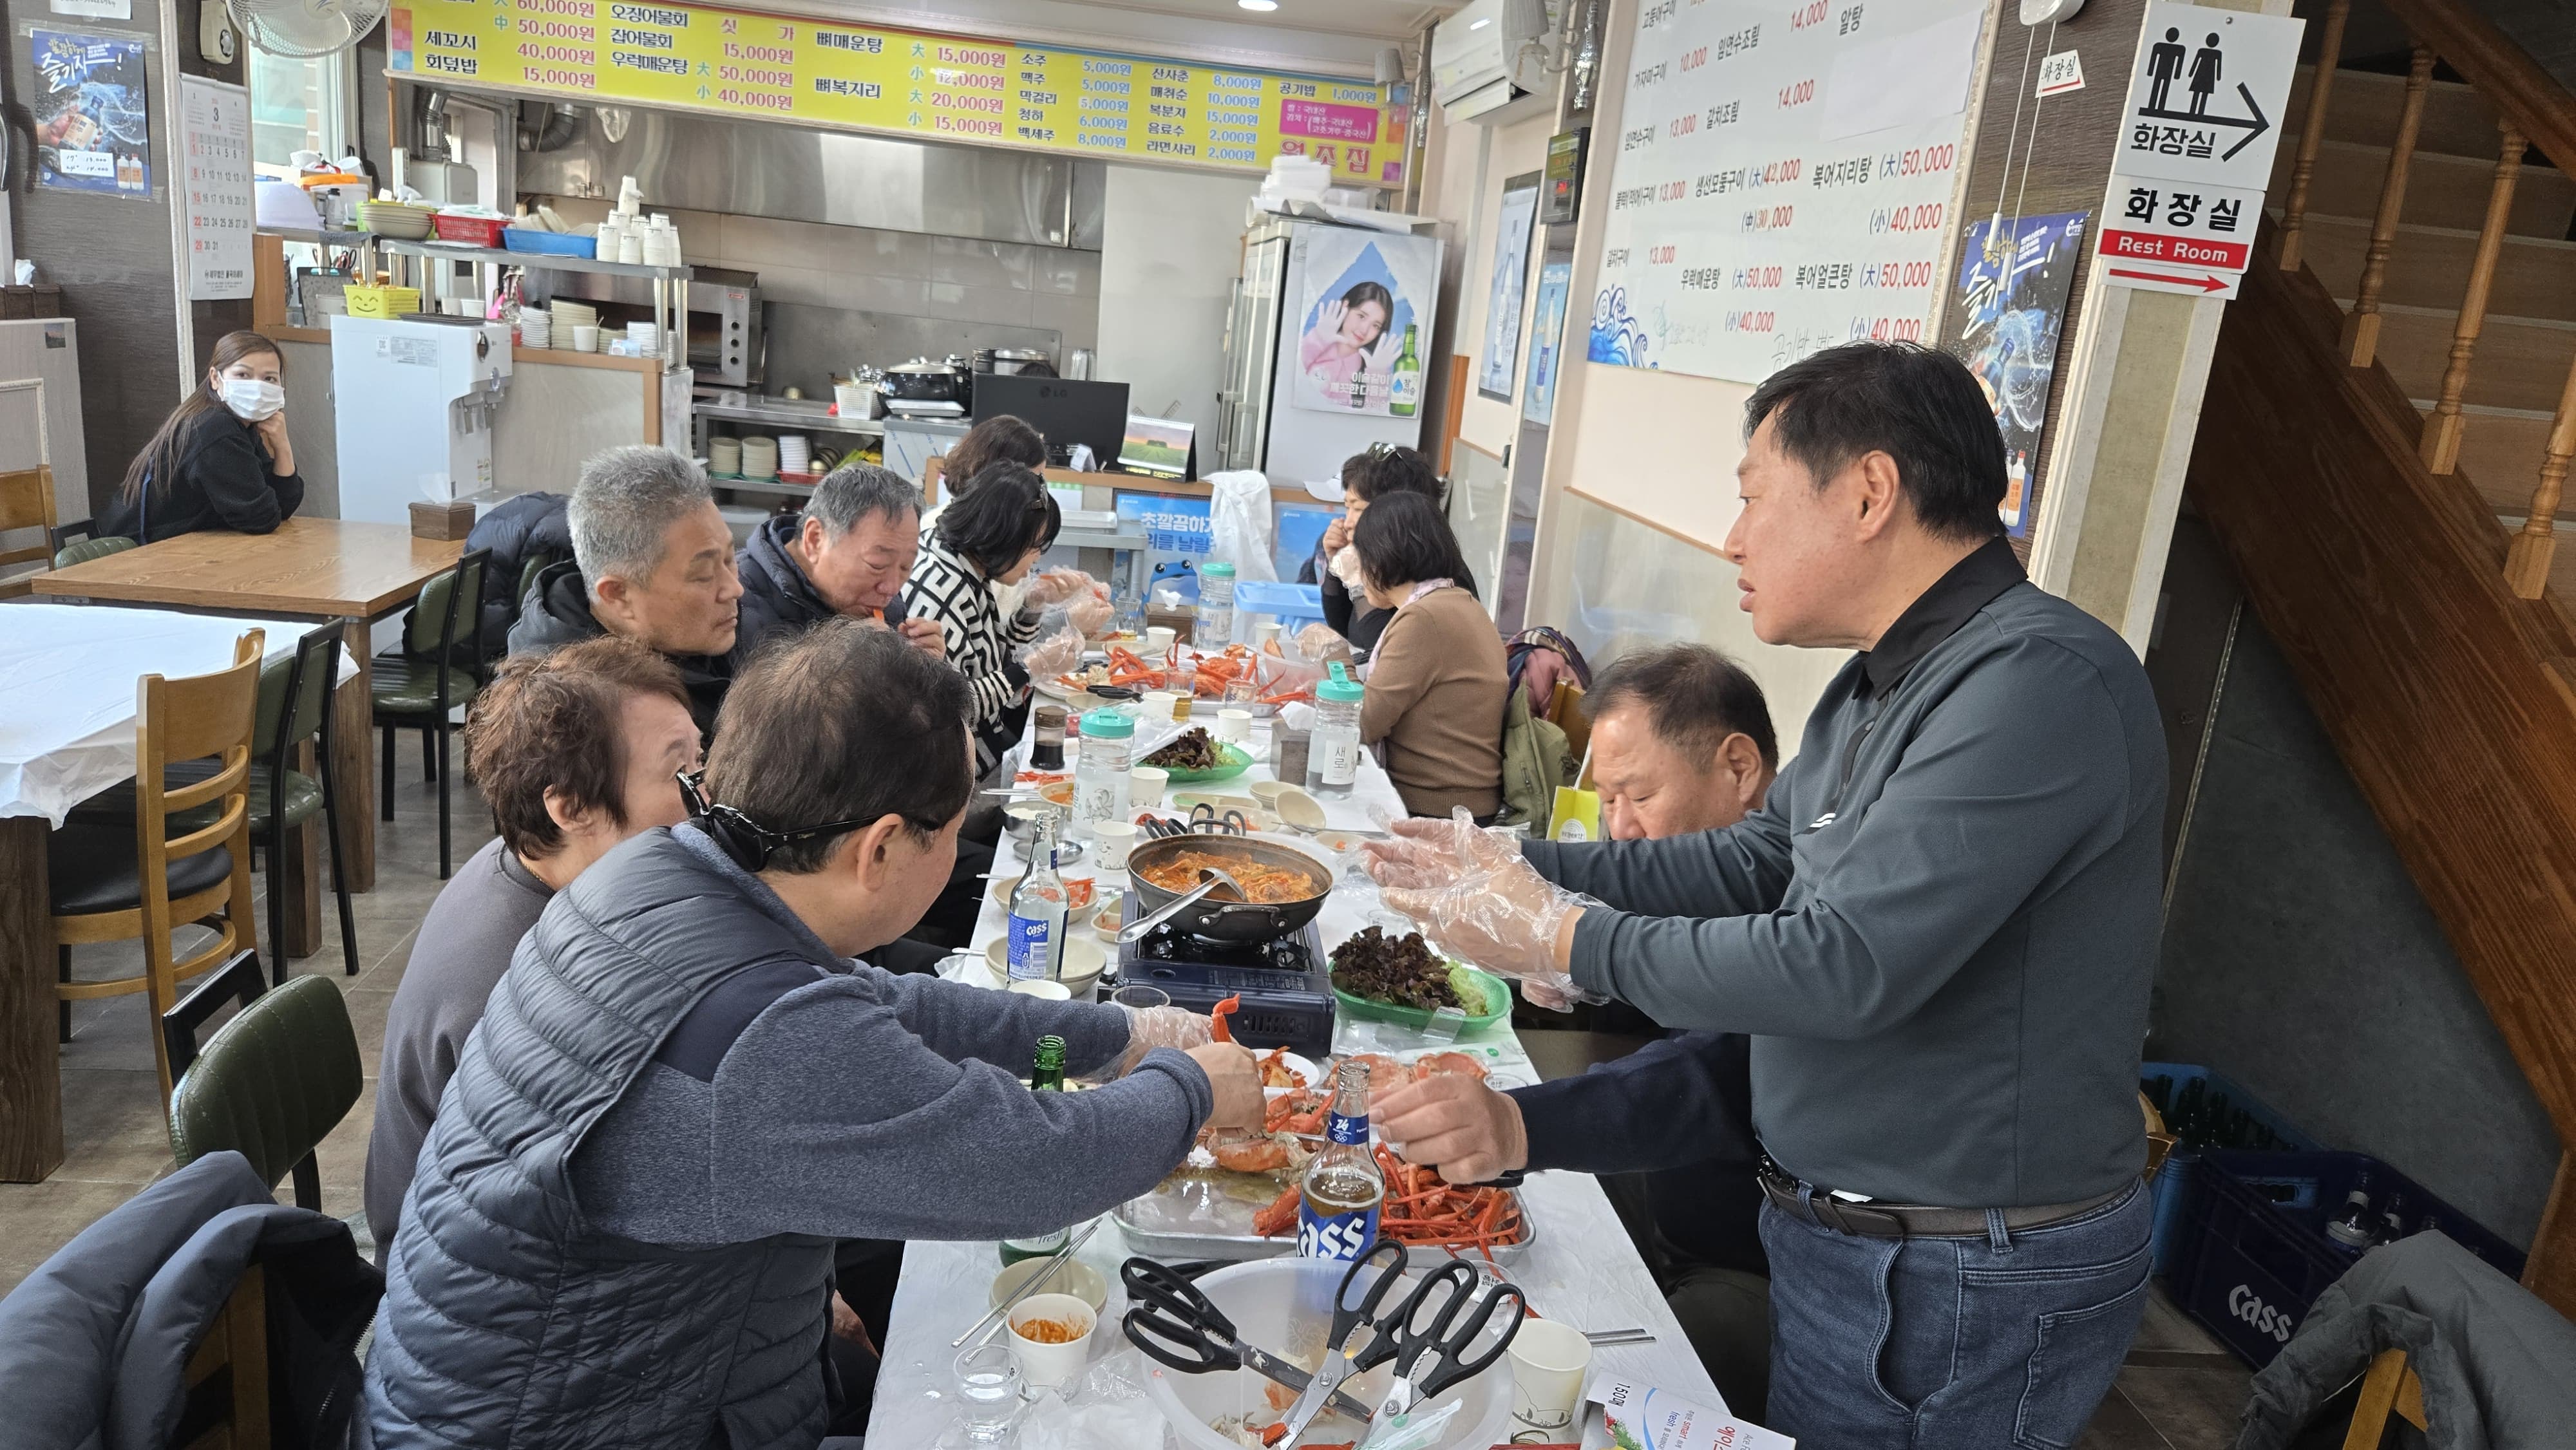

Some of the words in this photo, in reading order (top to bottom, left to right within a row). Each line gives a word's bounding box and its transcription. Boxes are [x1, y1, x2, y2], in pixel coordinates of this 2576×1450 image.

[611, 5, 688, 28] 오징어물회
[778, 26, 794, 41] 가
[1642, 0, 1676, 29] 고등어구이
[1790, 0, 1828, 32] 14,000
[1839, 3, 1863, 36] 알탕
[495, 15, 507, 30] 中
[518, 19, 594, 42] 50,000원
[425, 31, 476, 50] 세꼬시
[518, 43, 594, 65] 40,000원
[611, 28, 672, 49] 잡어물회
[723, 43, 793, 64] 15,000원
[912, 43, 924, 58] 大
[938, 46, 1005, 68] 15,000원
[1634, 60, 1667, 90] 가자미구이
[1718, 23, 1760, 61] 임연수조림
[426, 54, 477, 74] 회덮밥
[524, 67, 594, 89] 15,000원
[611, 52, 688, 75] 우럭매운탕
[696, 62, 710, 77] 大
[719, 66, 793, 88] 50,000원
[910, 66, 924, 81] 小
[1021, 54, 1046, 66] 소주
[1083, 61, 1132, 76] 5,000원
[1021, 72, 1045, 85] 맥주
[1082, 79, 1130, 94] 5,000원
[1152, 68, 1188, 82] 산사춘
[1213, 75, 1261, 90] 8,000원
[697, 85, 710, 99] 小
[718, 89, 792, 111] 40,000원
[910, 89, 923, 104] 大
[932, 93, 1003, 113] 20,000원
[1020, 91, 1057, 105] 막걸리
[1081, 98, 1128, 112] 5,000원
[1151, 86, 1187, 101] 매취순
[1208, 93, 1260, 108] 10,000원
[1280, 82, 1316, 97] 공기밥
[1333, 88, 1376, 103] 1,000원
[1778, 79, 1814, 109] 14,000
[214, 107, 219, 122] 3
[909, 112, 922, 126] 小
[935, 115, 1002, 136] 15,000원
[1019, 108, 1043, 122] 청하
[1079, 116, 1127, 131] 6,000원
[1150, 105, 1186, 118] 복분자
[1208, 111, 1258, 126] 15,000원
[1625, 125, 1655, 151] 임연수구이
[1669, 114, 1696, 138] 13,000
[1707, 100, 1739, 129] 갈치조림
[1018, 127, 1054, 141] 백세주
[1078, 134, 1126, 149] 8,000원
[1148, 122, 1184, 137] 음료수
[1209, 129, 1256, 144] 2,000원
[2131, 123, 2216, 159] 화장실
[1147, 140, 1195, 156] 라면사리
[1208, 147, 1255, 162] 2,000원
[1813, 155, 1871, 189] 복어지리탕
[1659, 180, 1685, 203] 13,000
[1649, 246, 1675, 265] 13,000
[2118, 236, 2163, 255] Rest
[2174, 242, 2228, 262] Room
[1681, 267, 1720, 290] 우럭매운탕
[1795, 263, 1852, 290] 복어얼큰탕
[1334, 746, 1345, 768] 새로
[2229, 1285, 2292, 1342] Cass
[1608, 1383, 1631, 1407] 150매
[1666, 1411, 1680, 1427] fresh
[1678, 1420, 1691, 1440] smart
